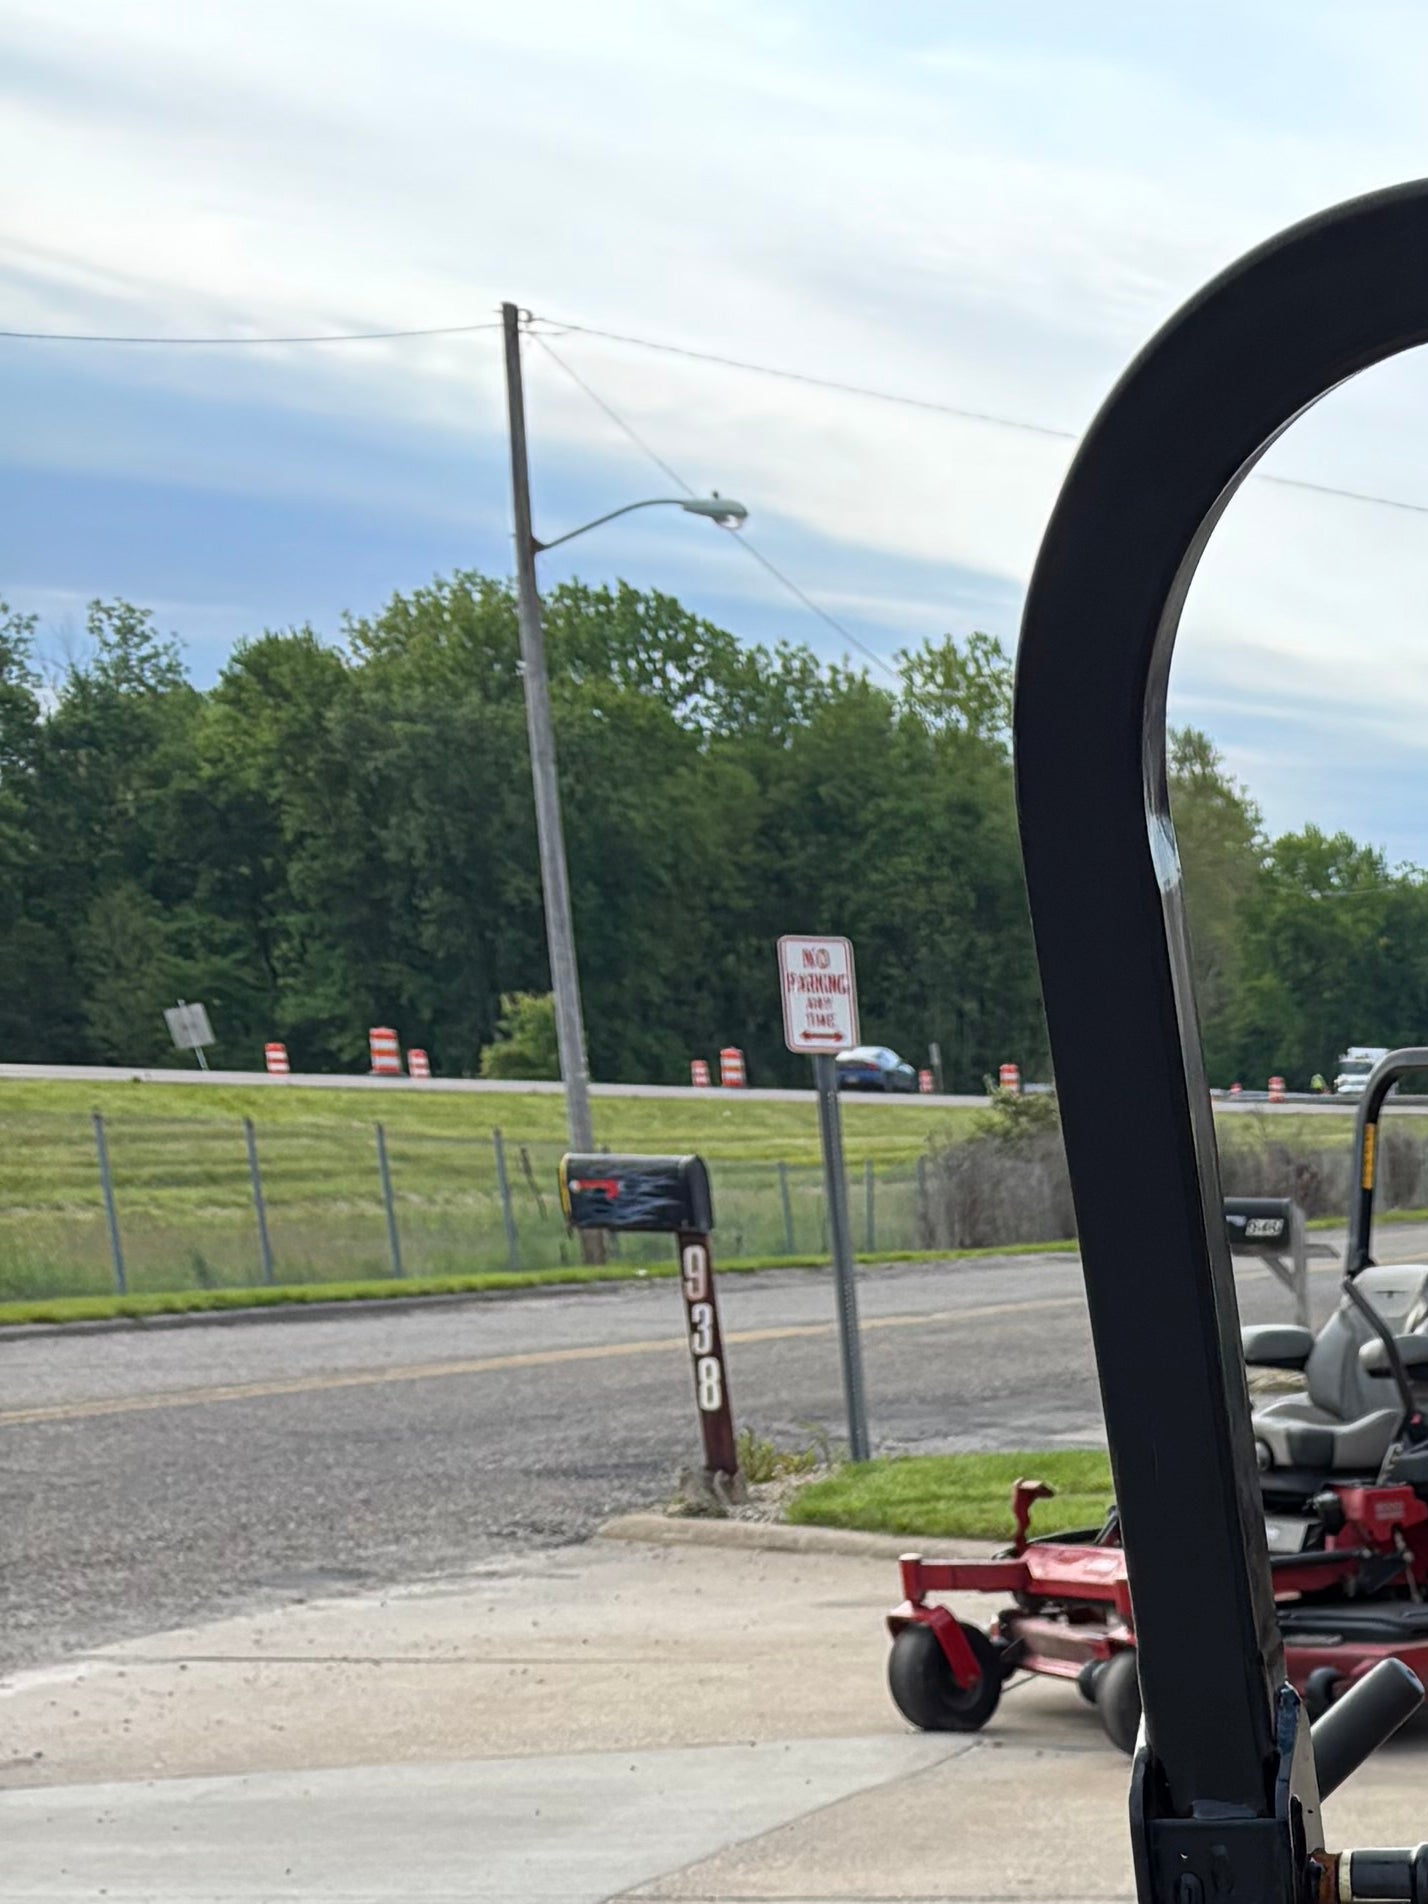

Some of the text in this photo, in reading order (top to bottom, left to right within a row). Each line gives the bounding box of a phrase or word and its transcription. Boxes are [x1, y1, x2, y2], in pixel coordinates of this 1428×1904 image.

[802, 948, 831, 969] NO
[786, 971, 849, 995] PARKING
[806, 997, 833, 1011] ANY
[806, 1012, 835, 1028] TIME
[682, 1244, 723, 1412] 938
